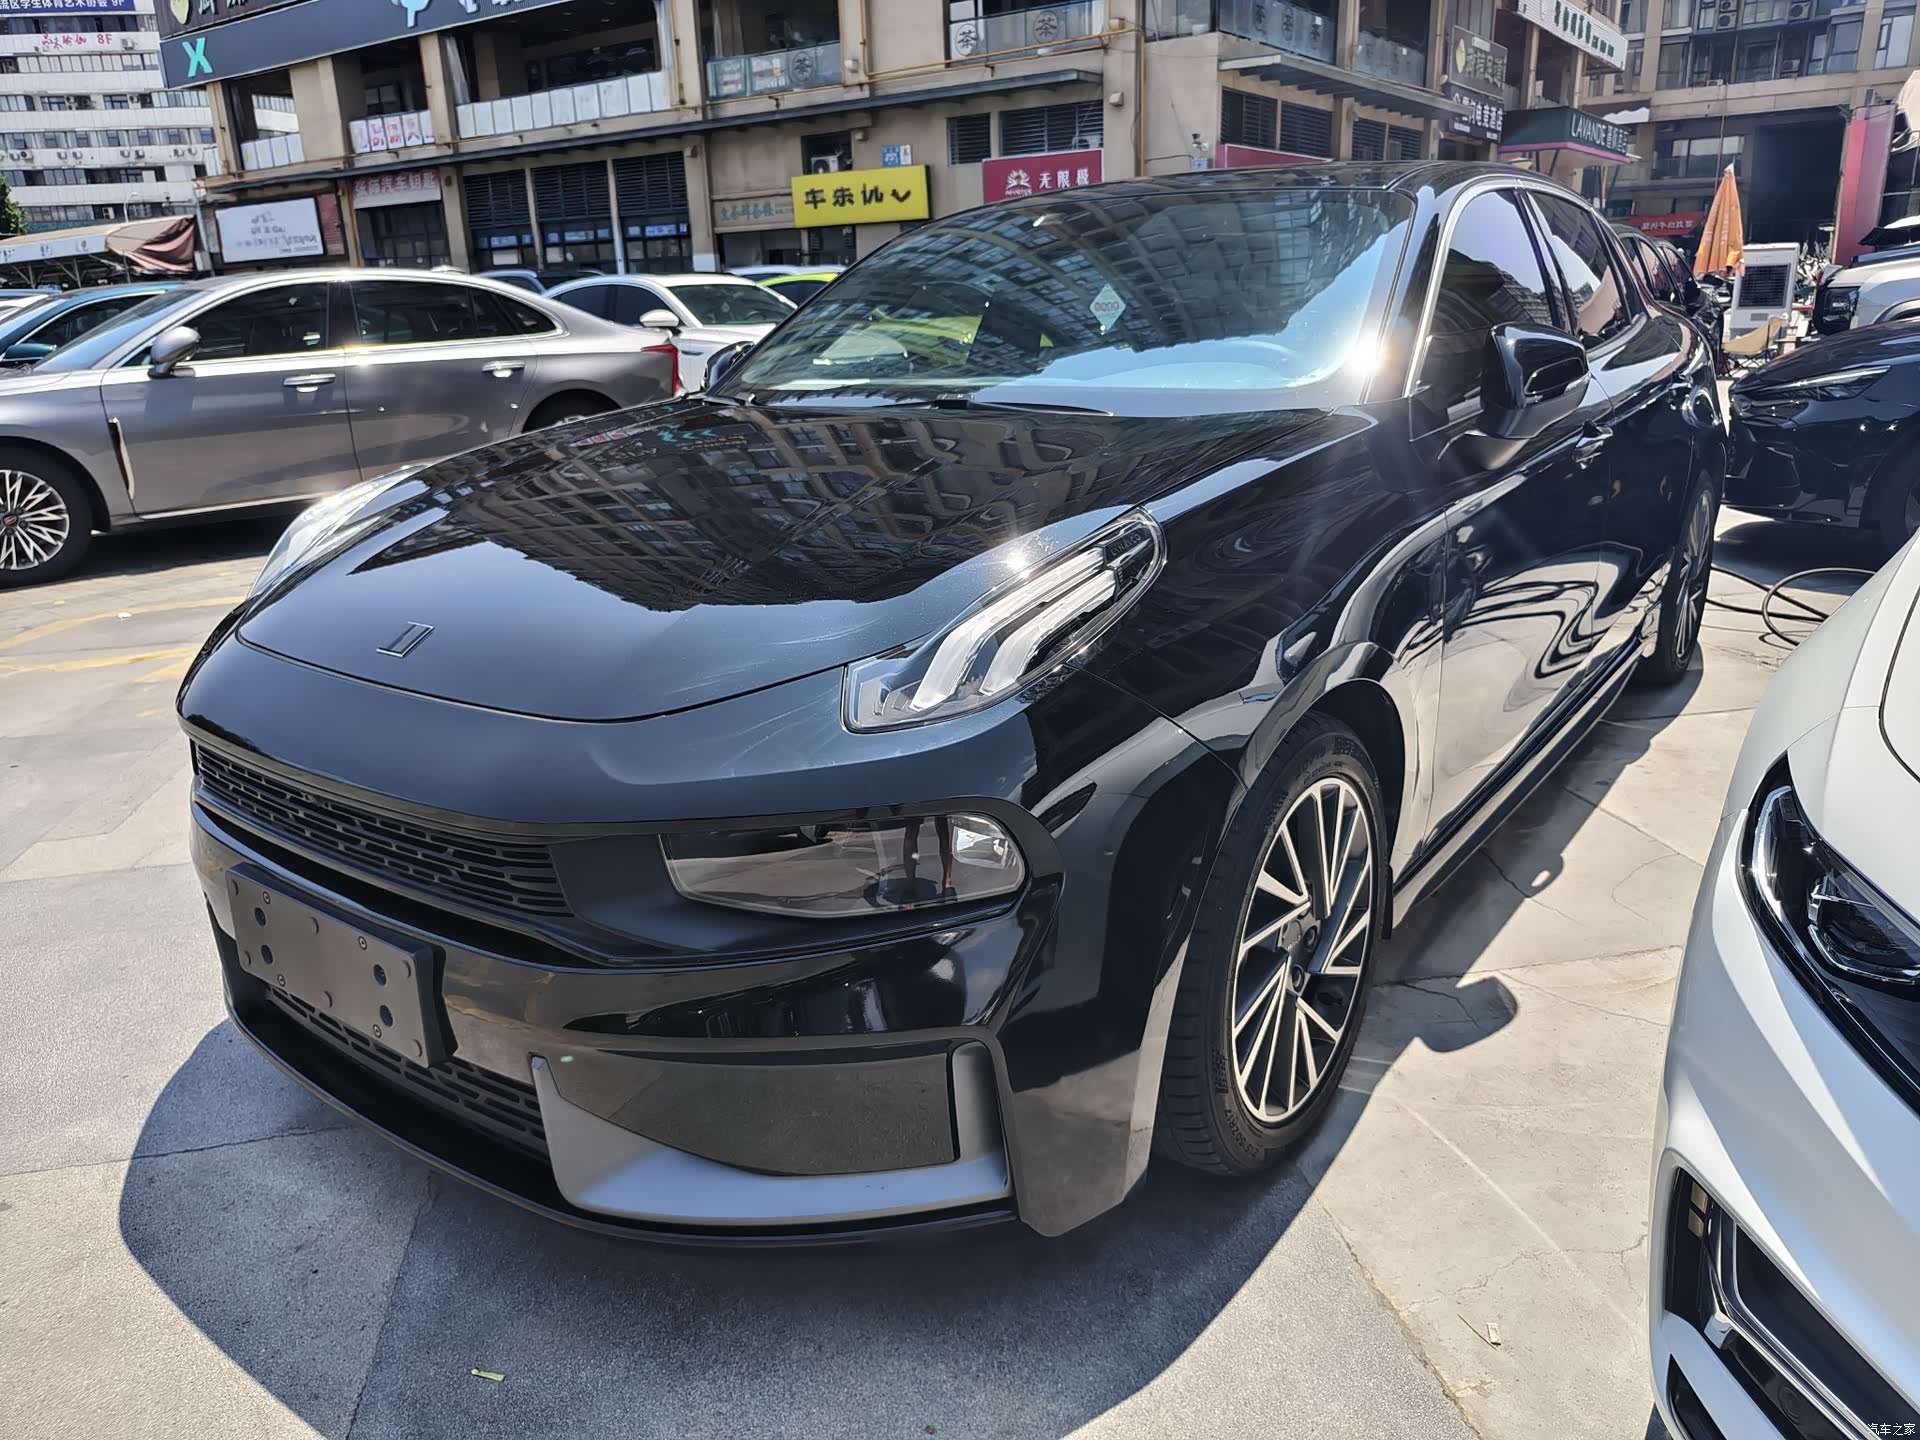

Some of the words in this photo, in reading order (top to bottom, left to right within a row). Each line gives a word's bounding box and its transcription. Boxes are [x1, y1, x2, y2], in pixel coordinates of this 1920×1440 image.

[1035, 18, 1058, 37] 茶
[96, 34, 113, 45] 8F
[957, 29, 978, 49] 茶
[1571, 112, 1606, 146] LAVANDE
[1039, 167, 1090, 189] 无限极
